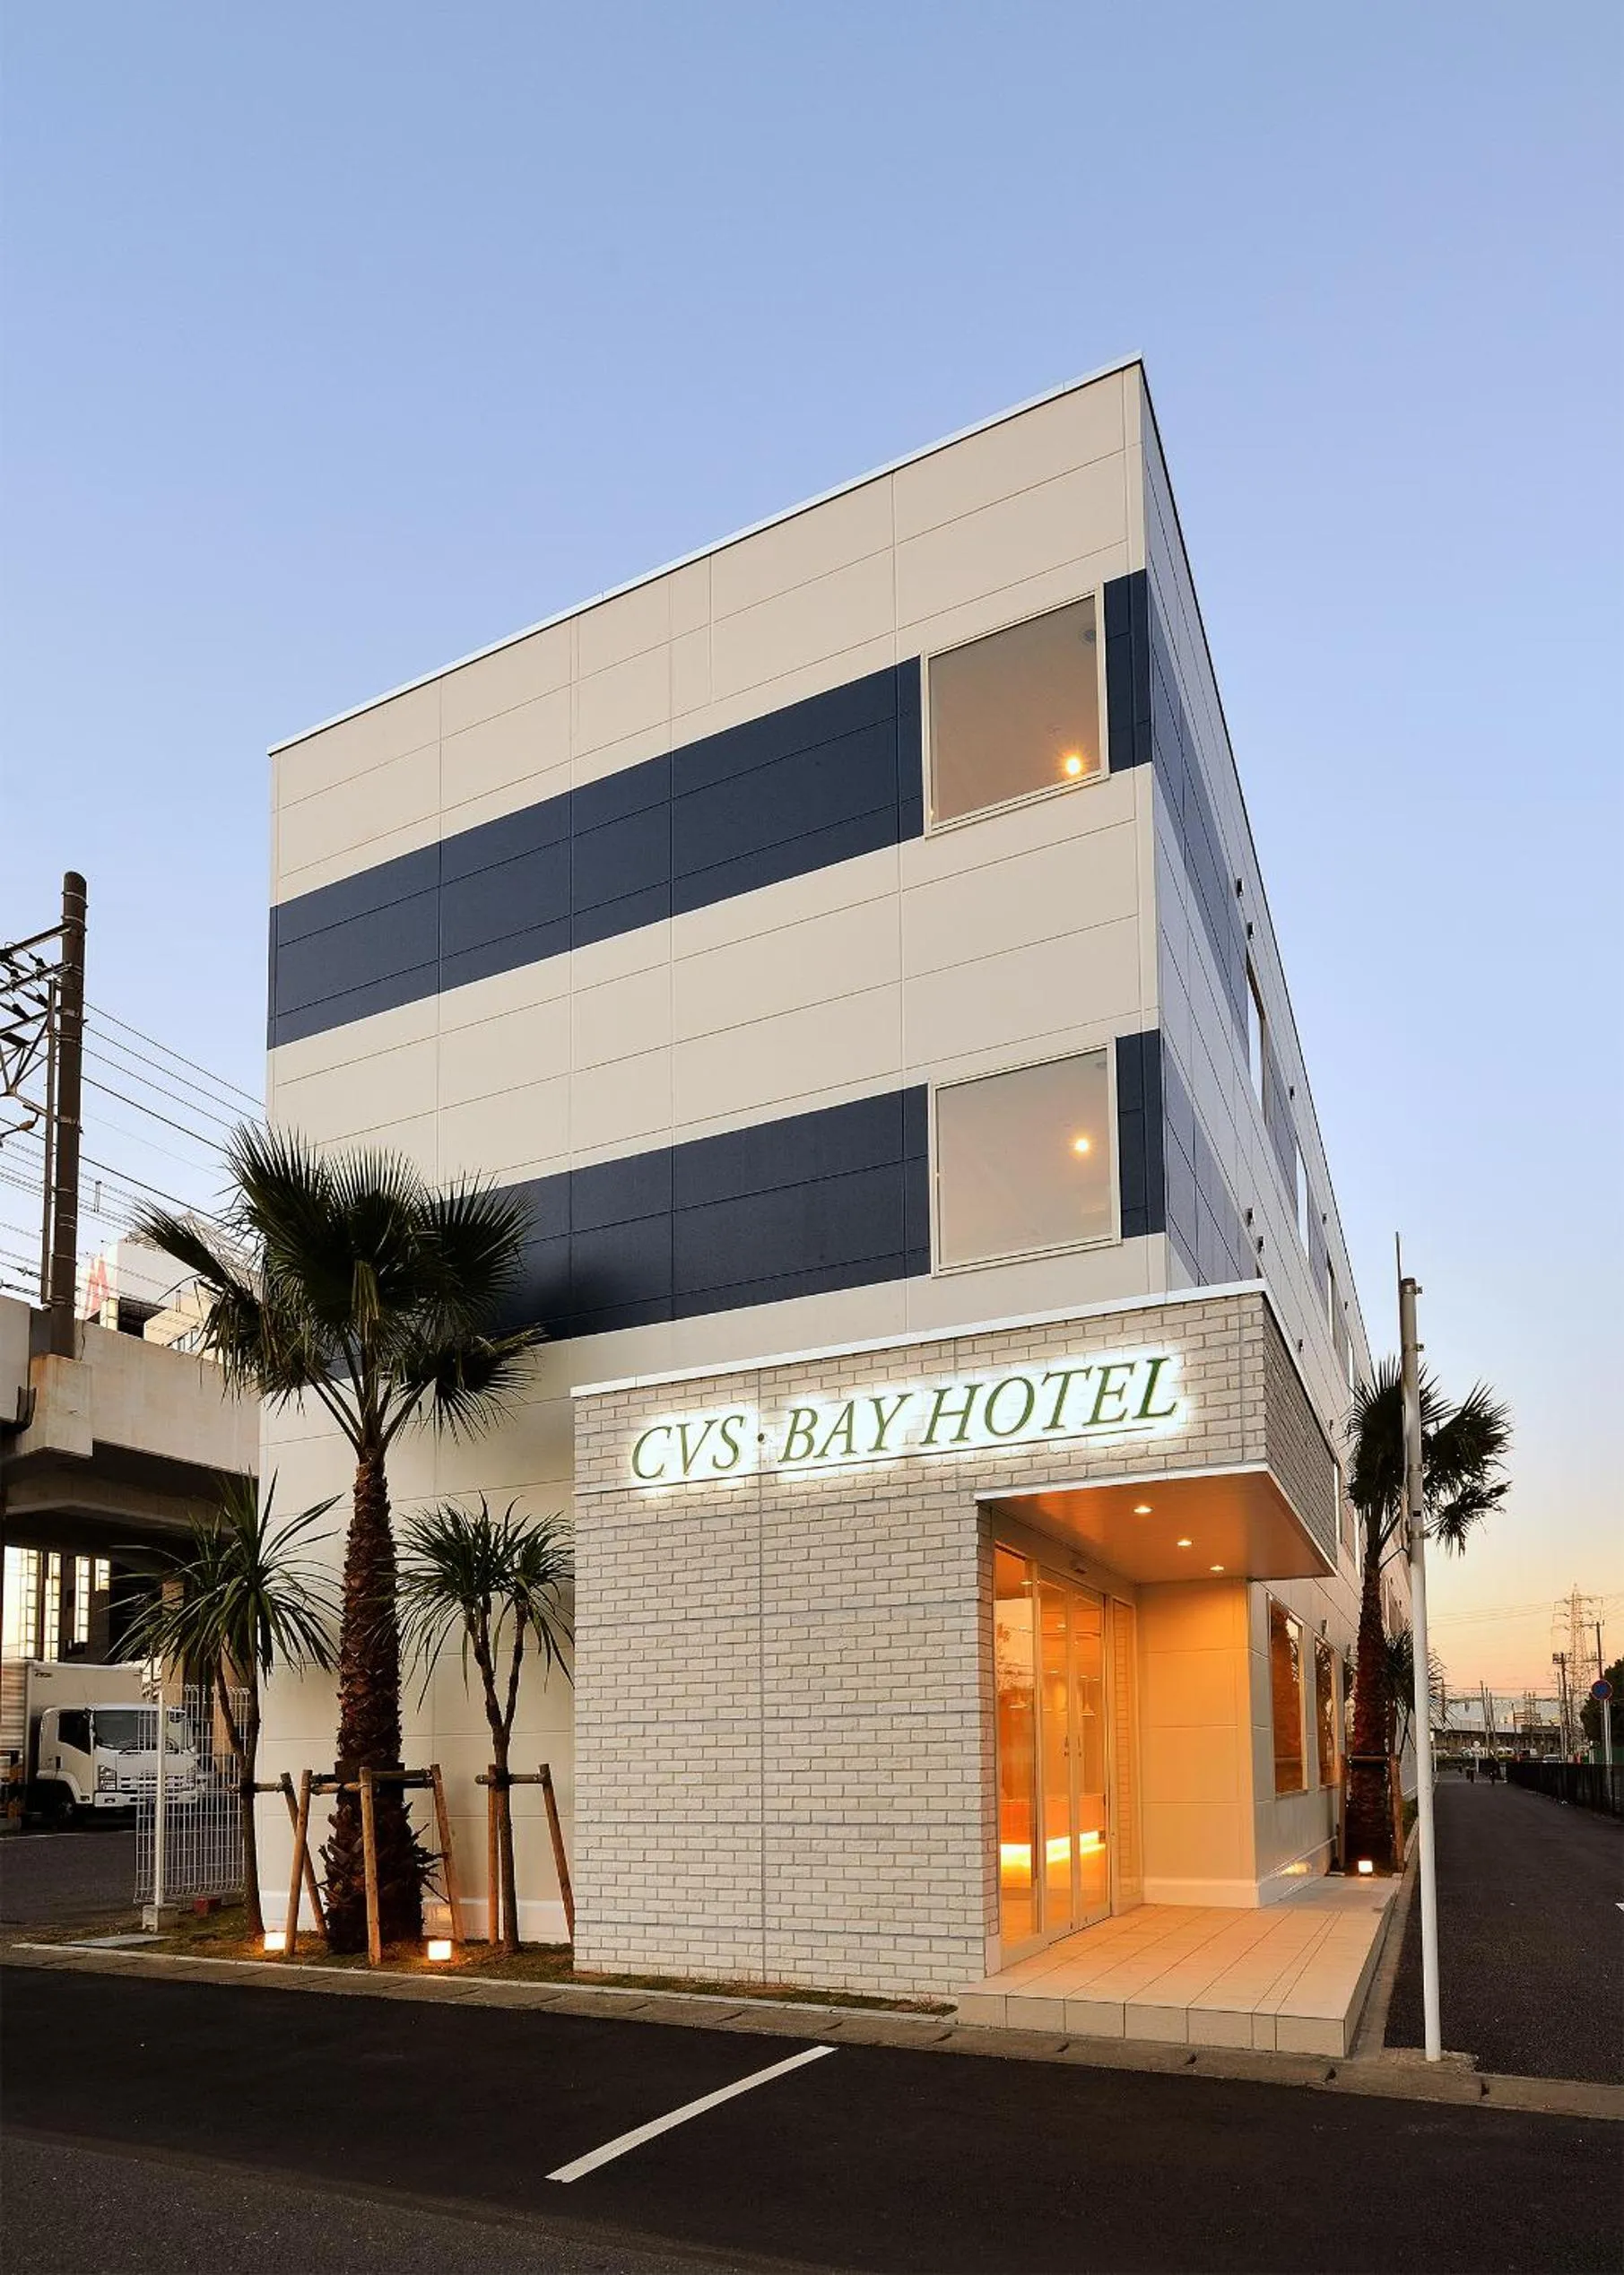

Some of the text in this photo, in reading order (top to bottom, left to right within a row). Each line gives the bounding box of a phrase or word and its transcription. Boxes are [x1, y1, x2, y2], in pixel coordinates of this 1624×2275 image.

[631, 1414, 745, 1480] CVS
[777, 1393, 915, 1463] BAY
[919, 1357, 1178, 1445] HOTEL
